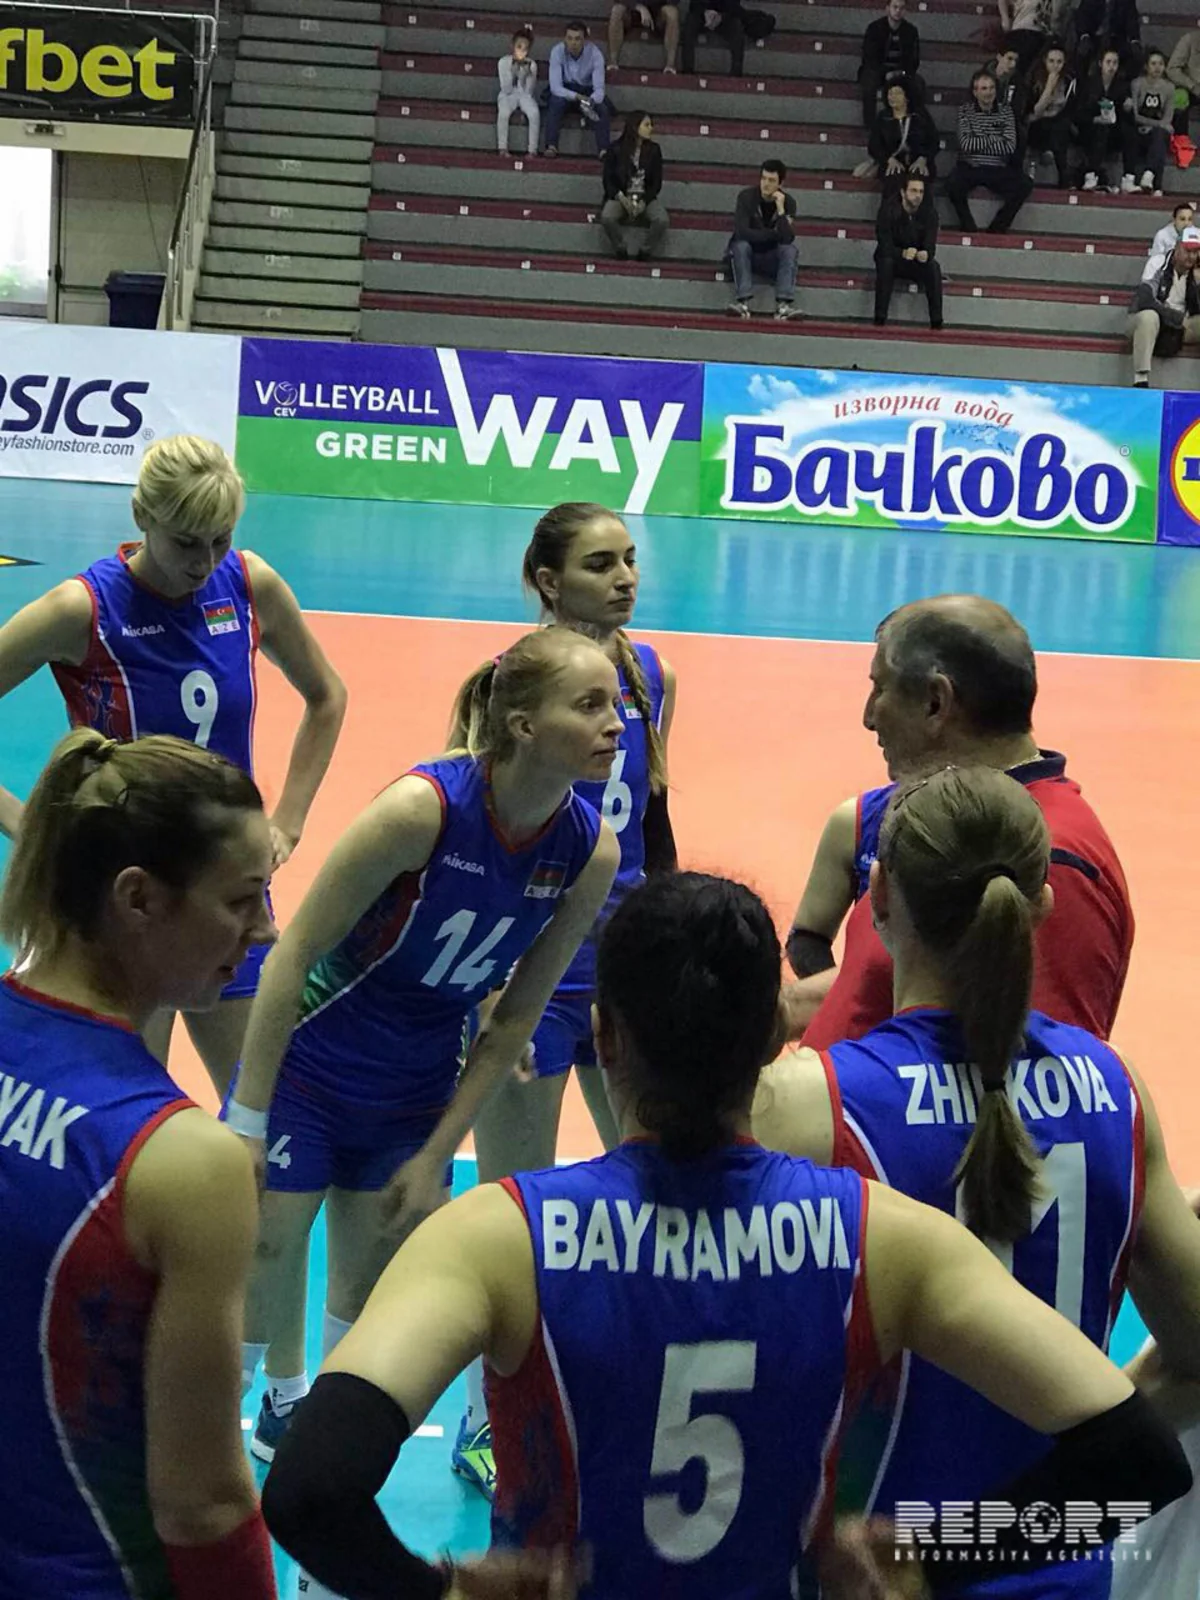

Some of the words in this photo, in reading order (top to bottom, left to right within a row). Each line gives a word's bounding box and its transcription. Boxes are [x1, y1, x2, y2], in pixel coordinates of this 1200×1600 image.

[0, 374, 150, 439] SICS
[255, 380, 439, 415] VOLLEYBALL
[273, 407, 296, 417] CEV
[436, 347, 685, 514] WAY
[833, 395, 942, 419] изворна
[954, 400, 1014, 427] вода
[315, 430, 447, 464] GREEN
[727, 420, 1131, 526] Бачково
[181, 669, 219, 749] 9
[602, 749, 633, 834] 6
[420, 908, 516, 992] 14
[0, 1071, 90, 1170] YAK
[267, 1134, 292, 1169] 4
[643, 1339, 757, 1564] 5
